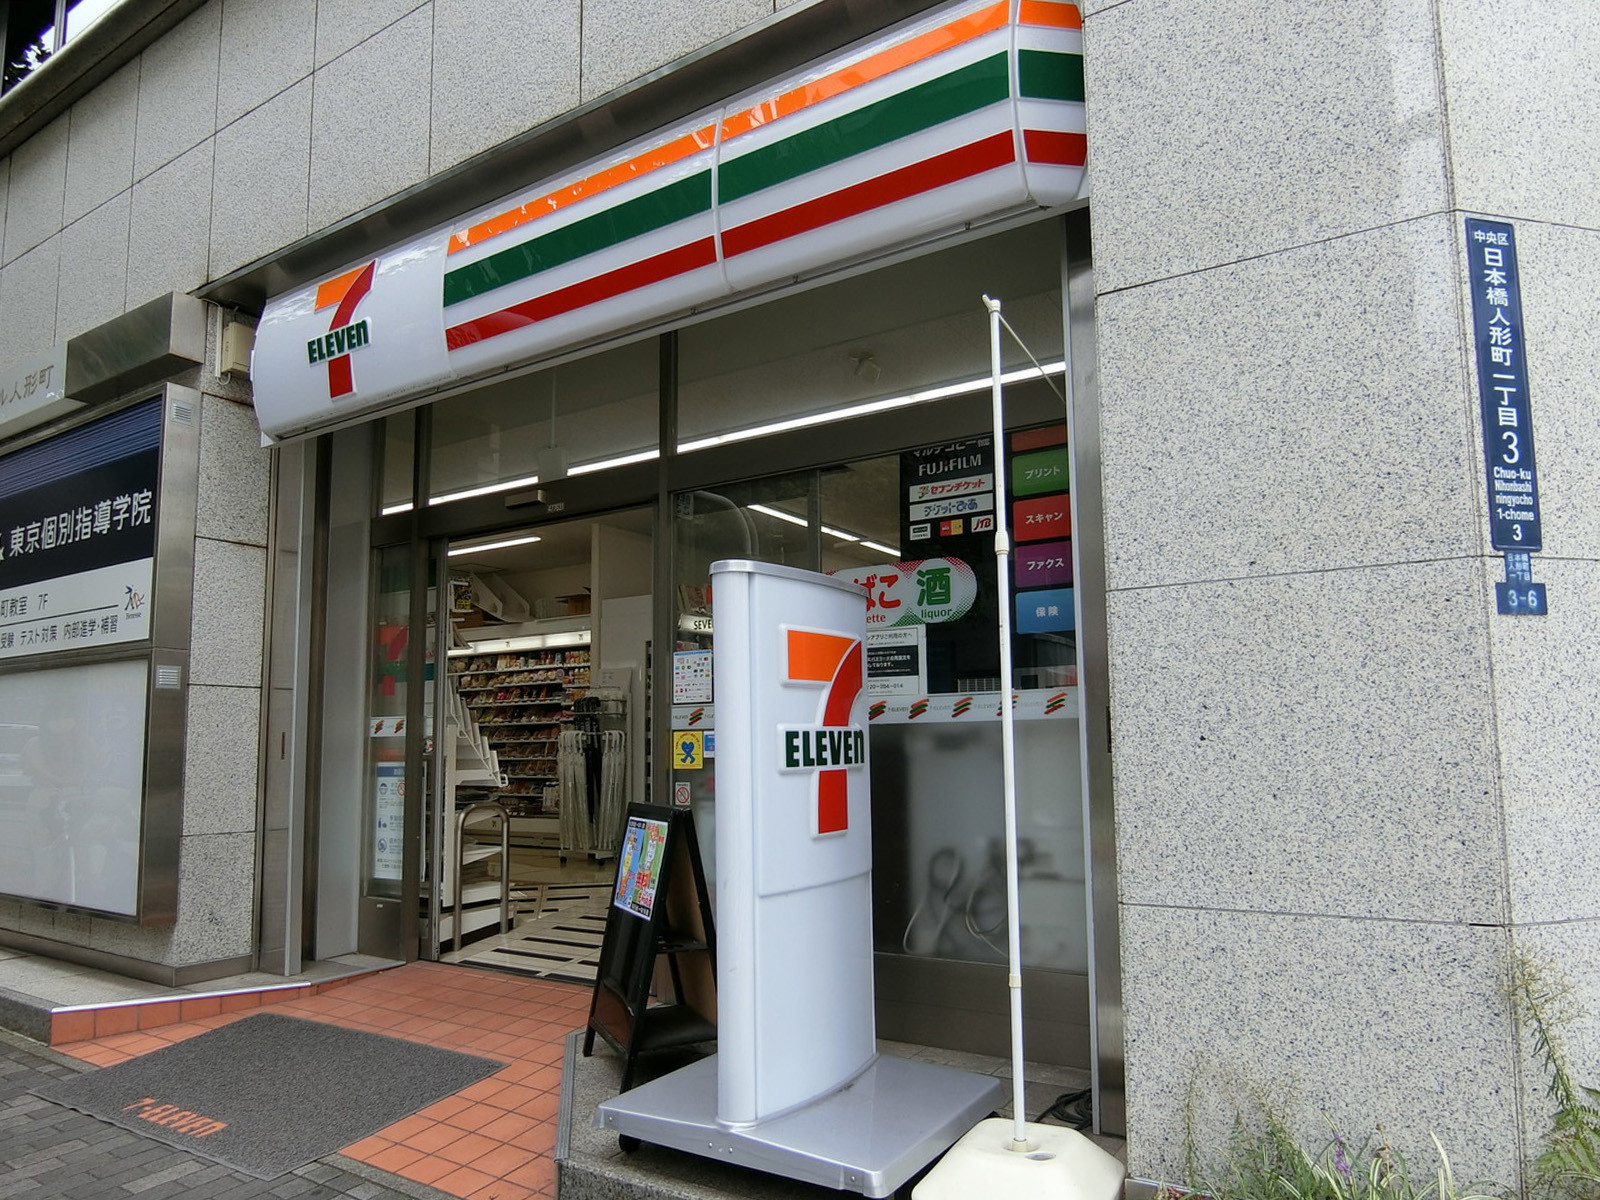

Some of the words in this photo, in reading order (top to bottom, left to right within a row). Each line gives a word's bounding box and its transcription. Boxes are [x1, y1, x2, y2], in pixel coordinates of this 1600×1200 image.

[1474, 230, 1509, 246] 中央区
[1502, 431, 1520, 465] 3
[1025, 466, 1061, 480] プリント
[1493, 466, 1532, 480] Chuo-ku
[930, 478, 986, 495] セブンチケット
[1494, 479, 1533, 493] Nihonbashi
[1495, 492, 1534, 507] ningyocho
[1025, 511, 1063, 525] スキャン
[1496, 507, 1535, 521] 1-chome
[9, 489, 152, 557] 東京個別指導学院
[973, 518, 992, 531] JTB
[1512, 523, 1523, 541] 3
[1026, 557, 1065, 571] ファクス
[854, 573, 901, 612] ばこ
[916, 567, 951, 607] 酒
[1508, 589, 1538, 607] 3-6
[921, 608, 953, 621] liquor
[693, 619, 713, 630] SEVE
